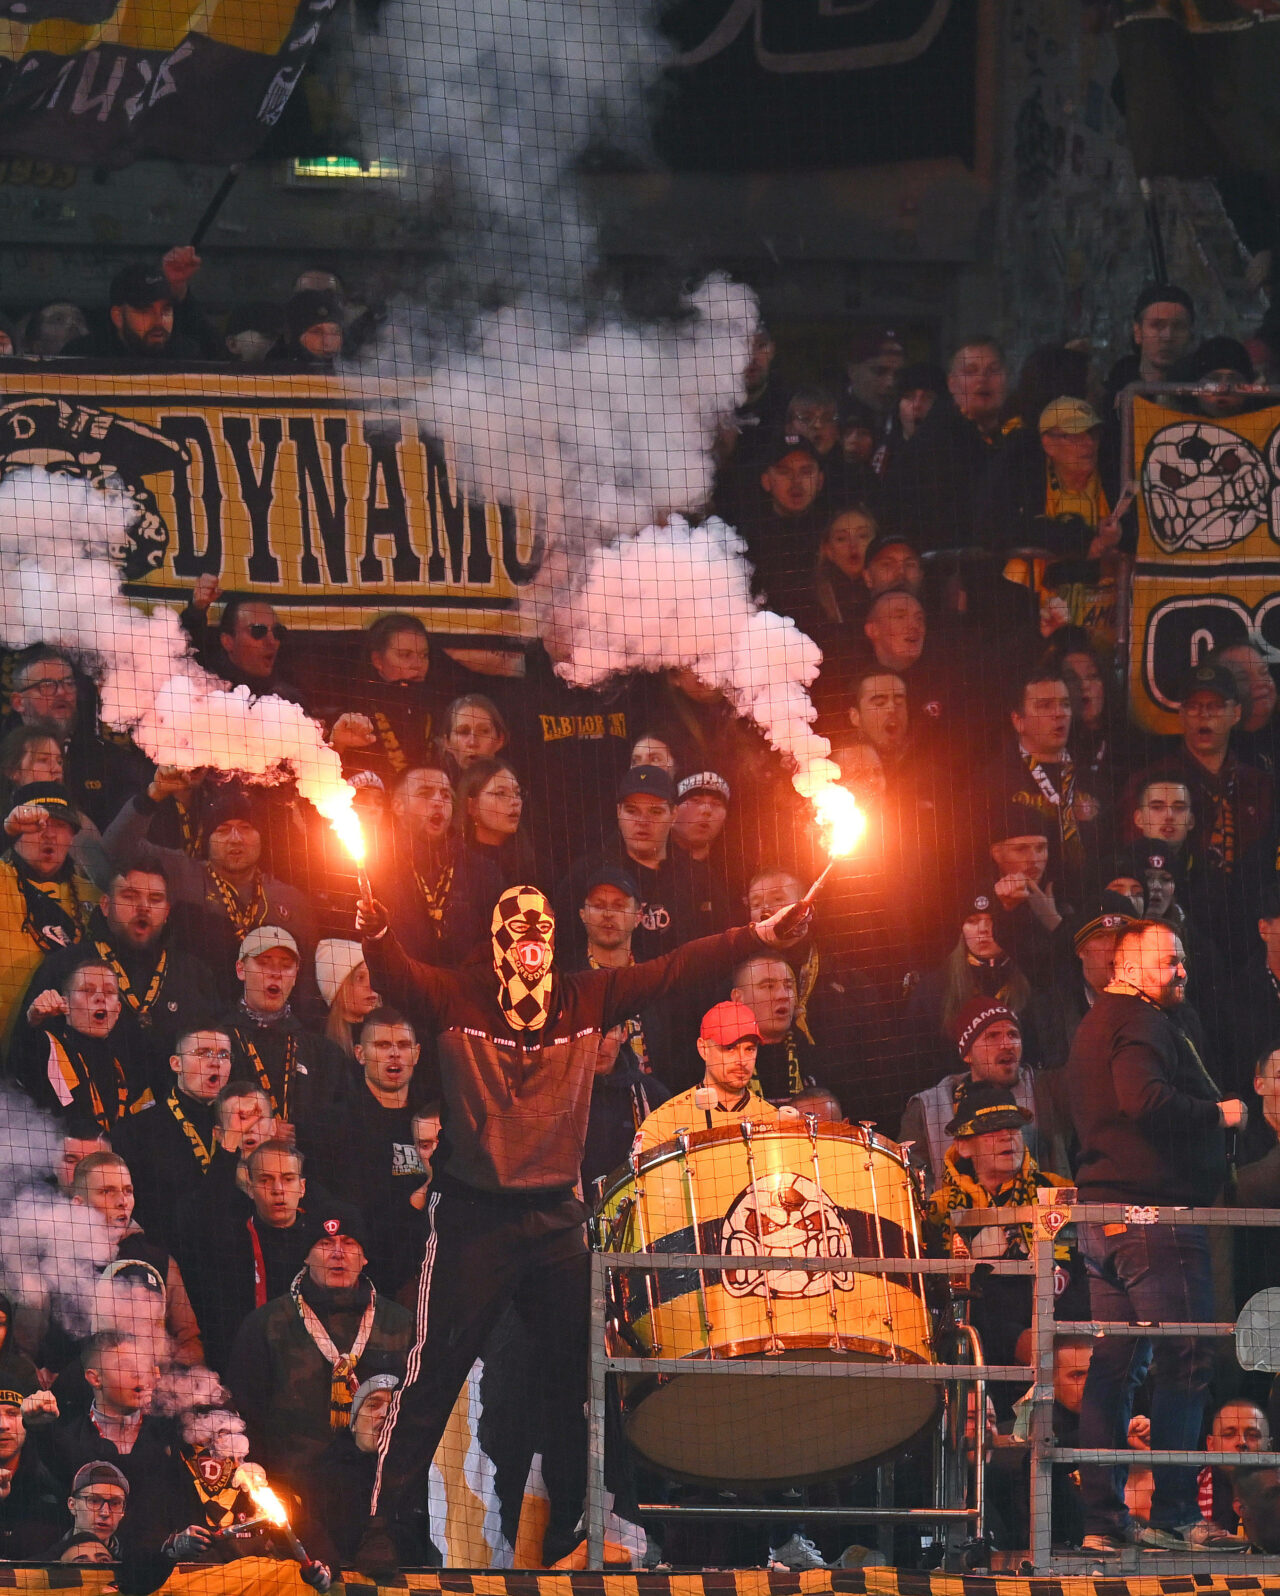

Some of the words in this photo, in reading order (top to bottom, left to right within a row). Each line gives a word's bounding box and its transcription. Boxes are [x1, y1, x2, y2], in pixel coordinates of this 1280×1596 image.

[521, 943, 545, 967] D
[515, 958, 550, 982] DRESDEN
[325, 1222, 339, 1234] D
[200, 1459, 223, 1480] D
